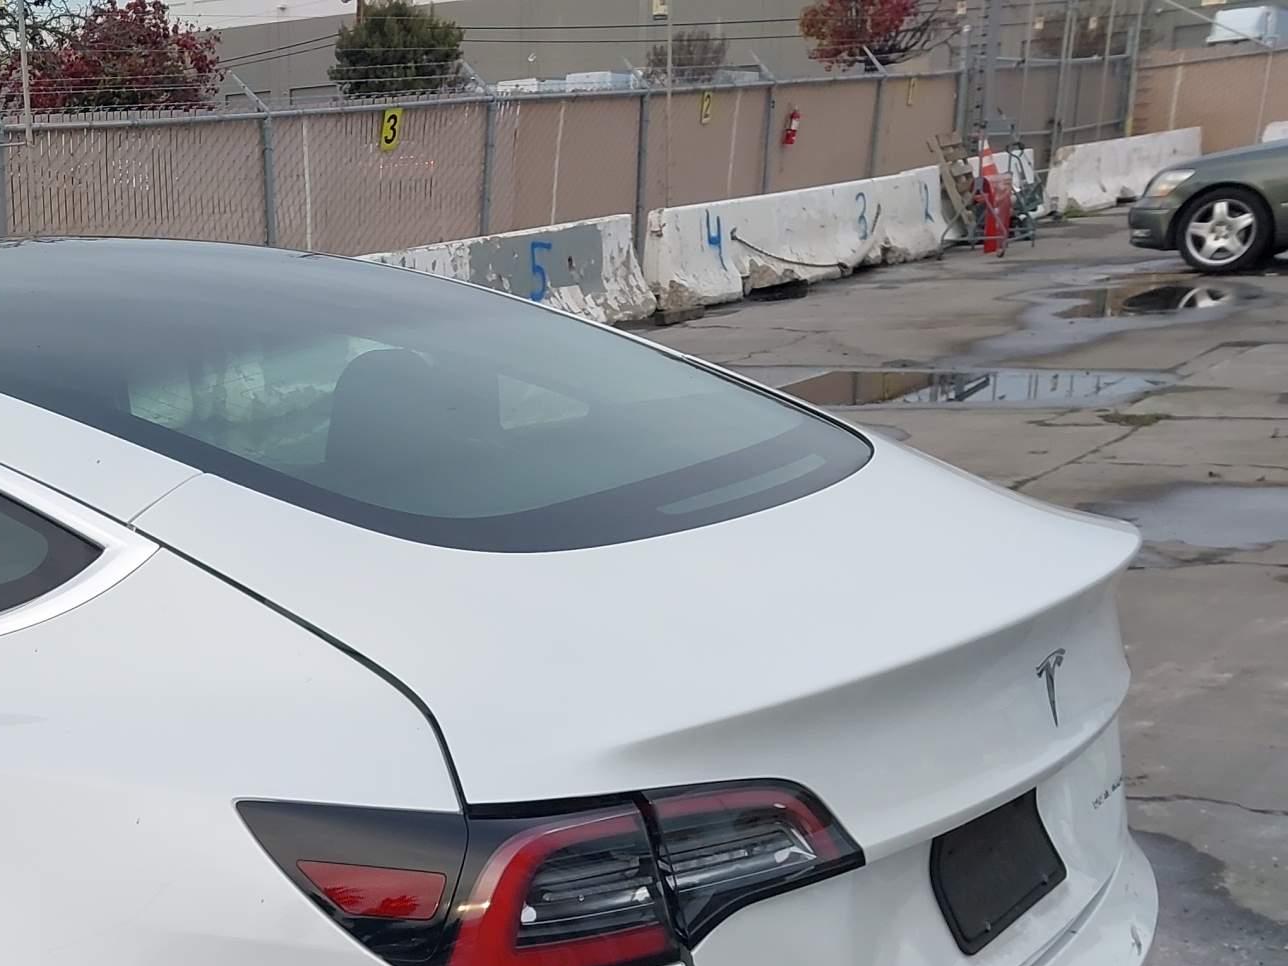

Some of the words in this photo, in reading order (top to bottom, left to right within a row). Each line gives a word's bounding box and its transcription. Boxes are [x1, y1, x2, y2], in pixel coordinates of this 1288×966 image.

[384, 114, 398, 144] 3
[705, 208, 728, 271] 4
[855, 191, 868, 240] 3
[530, 241, 553, 302] 5
